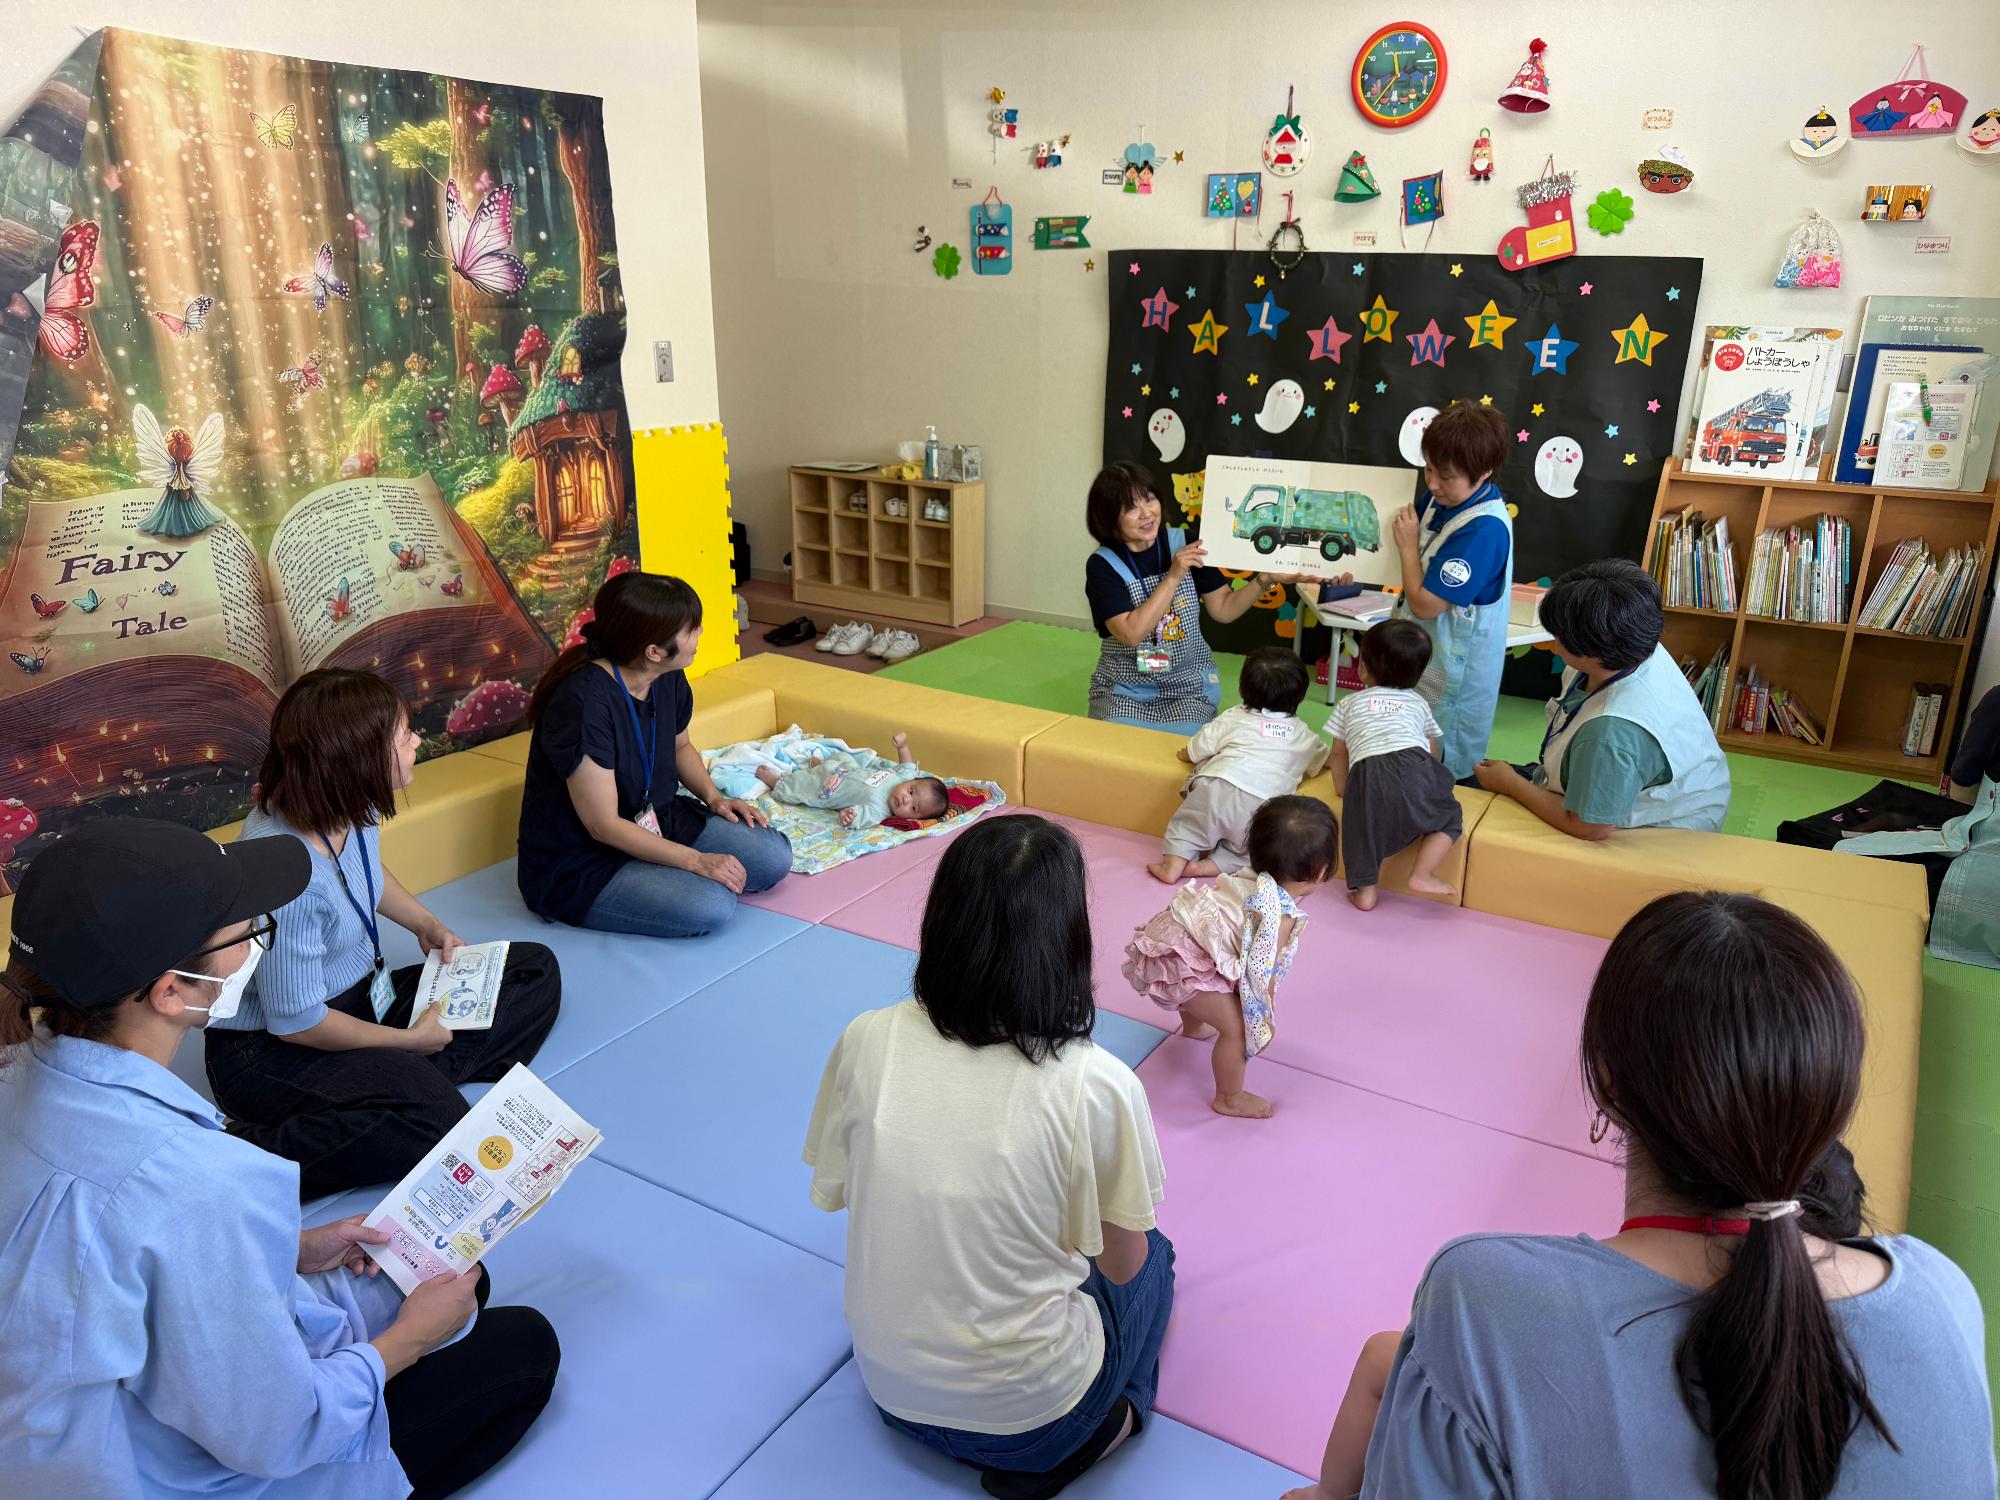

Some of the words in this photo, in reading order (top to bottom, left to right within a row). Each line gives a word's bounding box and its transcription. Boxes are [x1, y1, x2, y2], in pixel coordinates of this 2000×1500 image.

[1746, 356, 1811, 368] しょうぼうしゃ
[55, 545, 188, 585] Fairy
[112, 611, 188, 639] Tale
